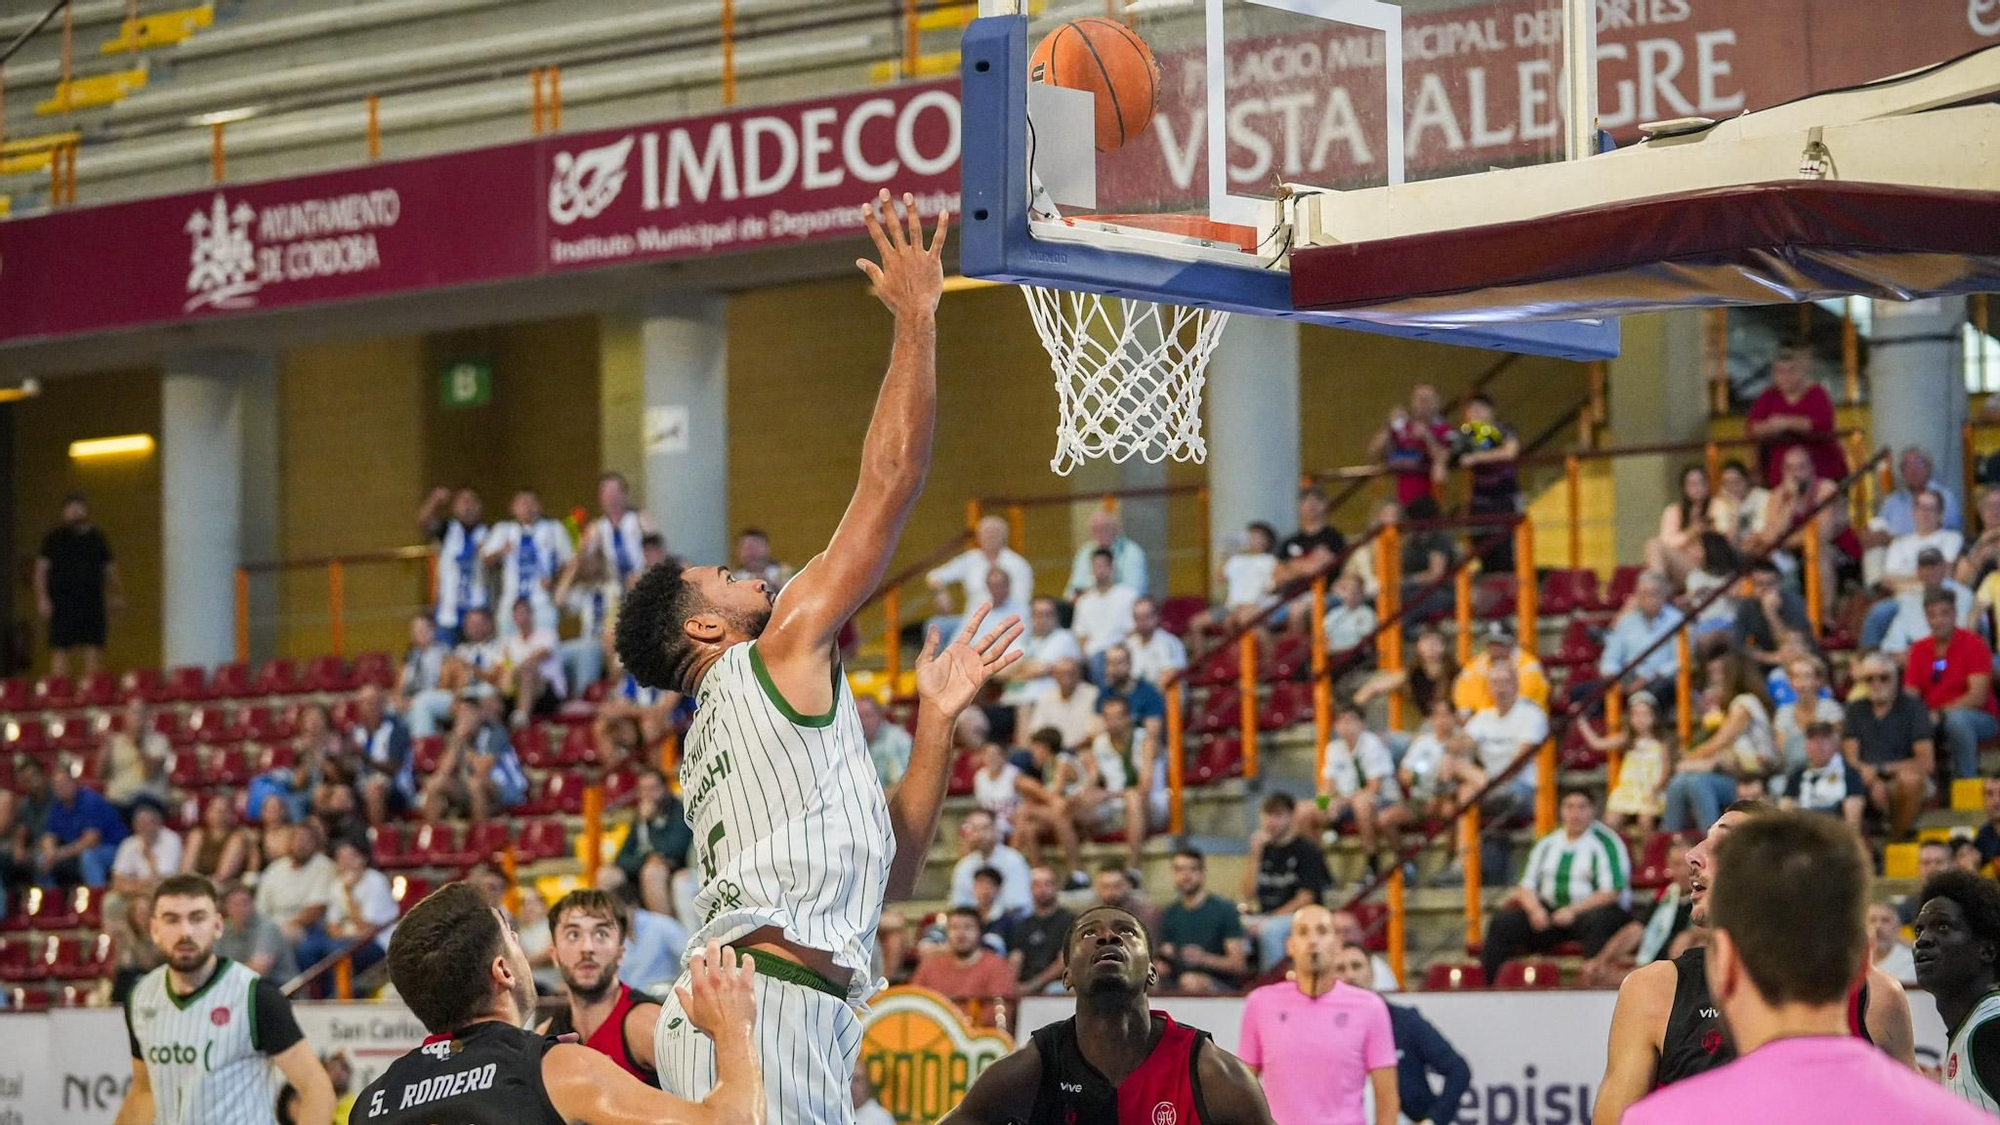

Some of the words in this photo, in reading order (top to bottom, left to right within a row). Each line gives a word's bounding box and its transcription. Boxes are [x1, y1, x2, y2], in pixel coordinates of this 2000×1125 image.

[640, 90, 962, 211] IMDECO
[1155, 87, 1376, 190] VSTA
[550, 234, 635, 263] Instituto
[636, 216, 737, 250] Municipal
[739, 214, 767, 240] de
[149, 1041, 198, 1064] coto
[368, 1089, 390, 1118] S.
[399, 1063, 497, 1110] ROMERO
[1060, 1082, 1082, 1093] vive
